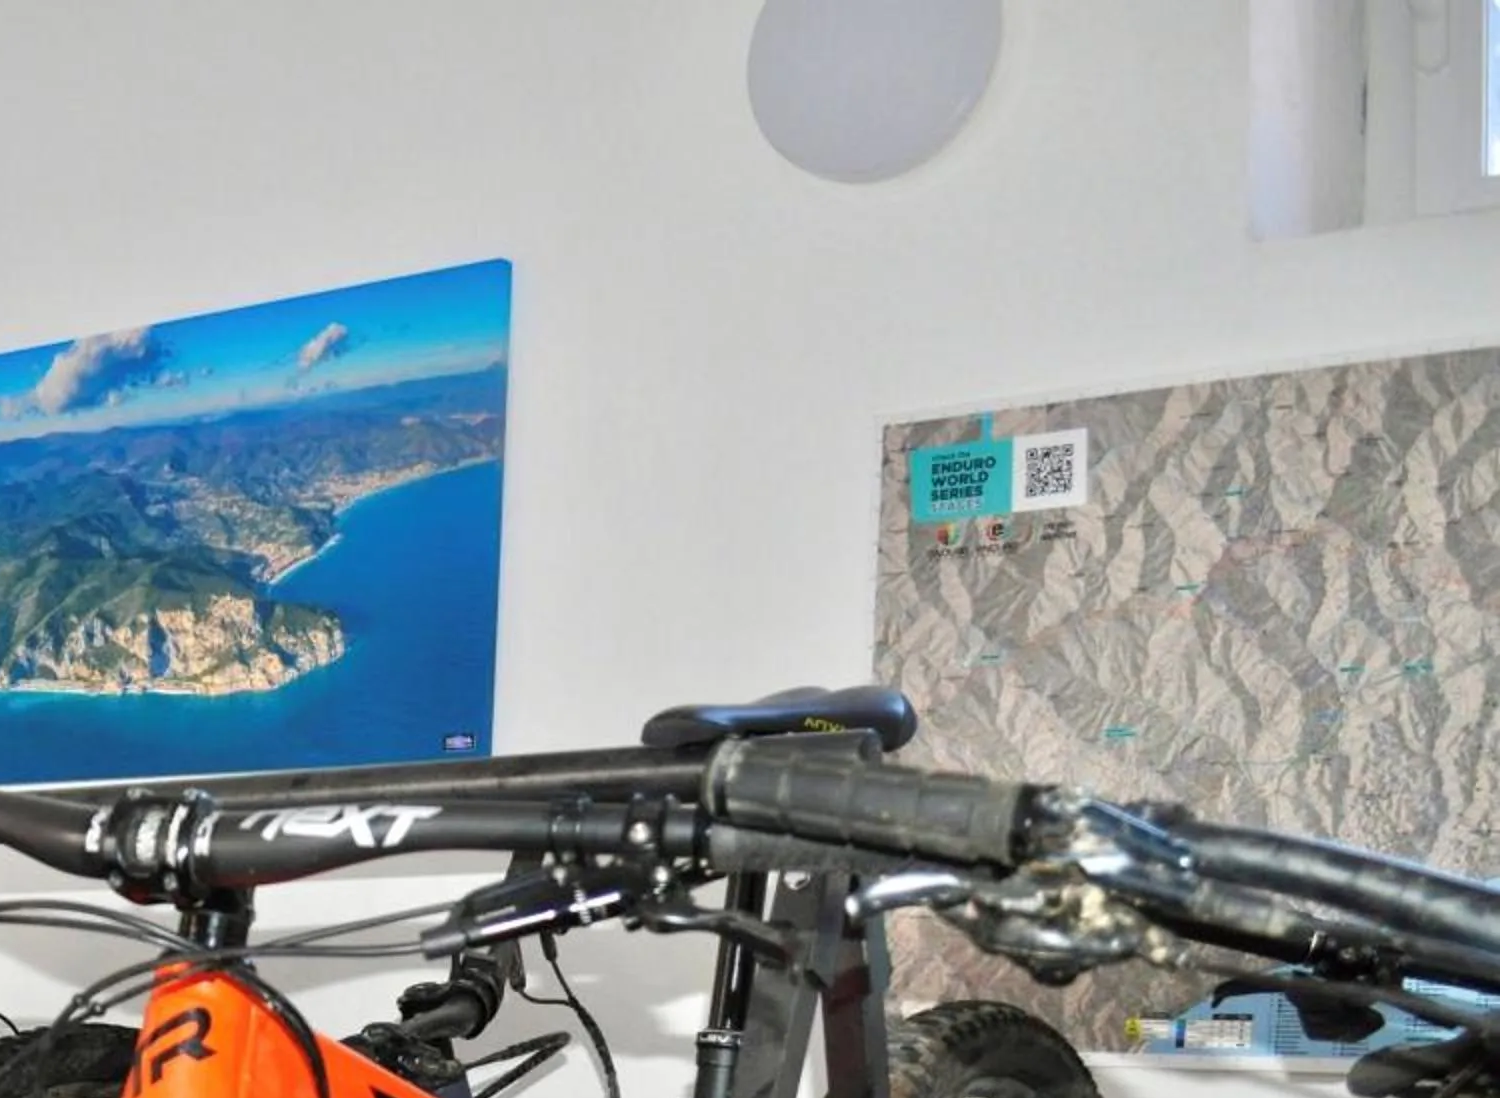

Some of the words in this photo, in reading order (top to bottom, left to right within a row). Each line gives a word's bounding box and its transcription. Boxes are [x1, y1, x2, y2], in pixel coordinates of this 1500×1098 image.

[931, 456, 997, 474] ENDURO
[931, 471, 989, 487] WORLD
[931, 485, 983, 501] SERIES
